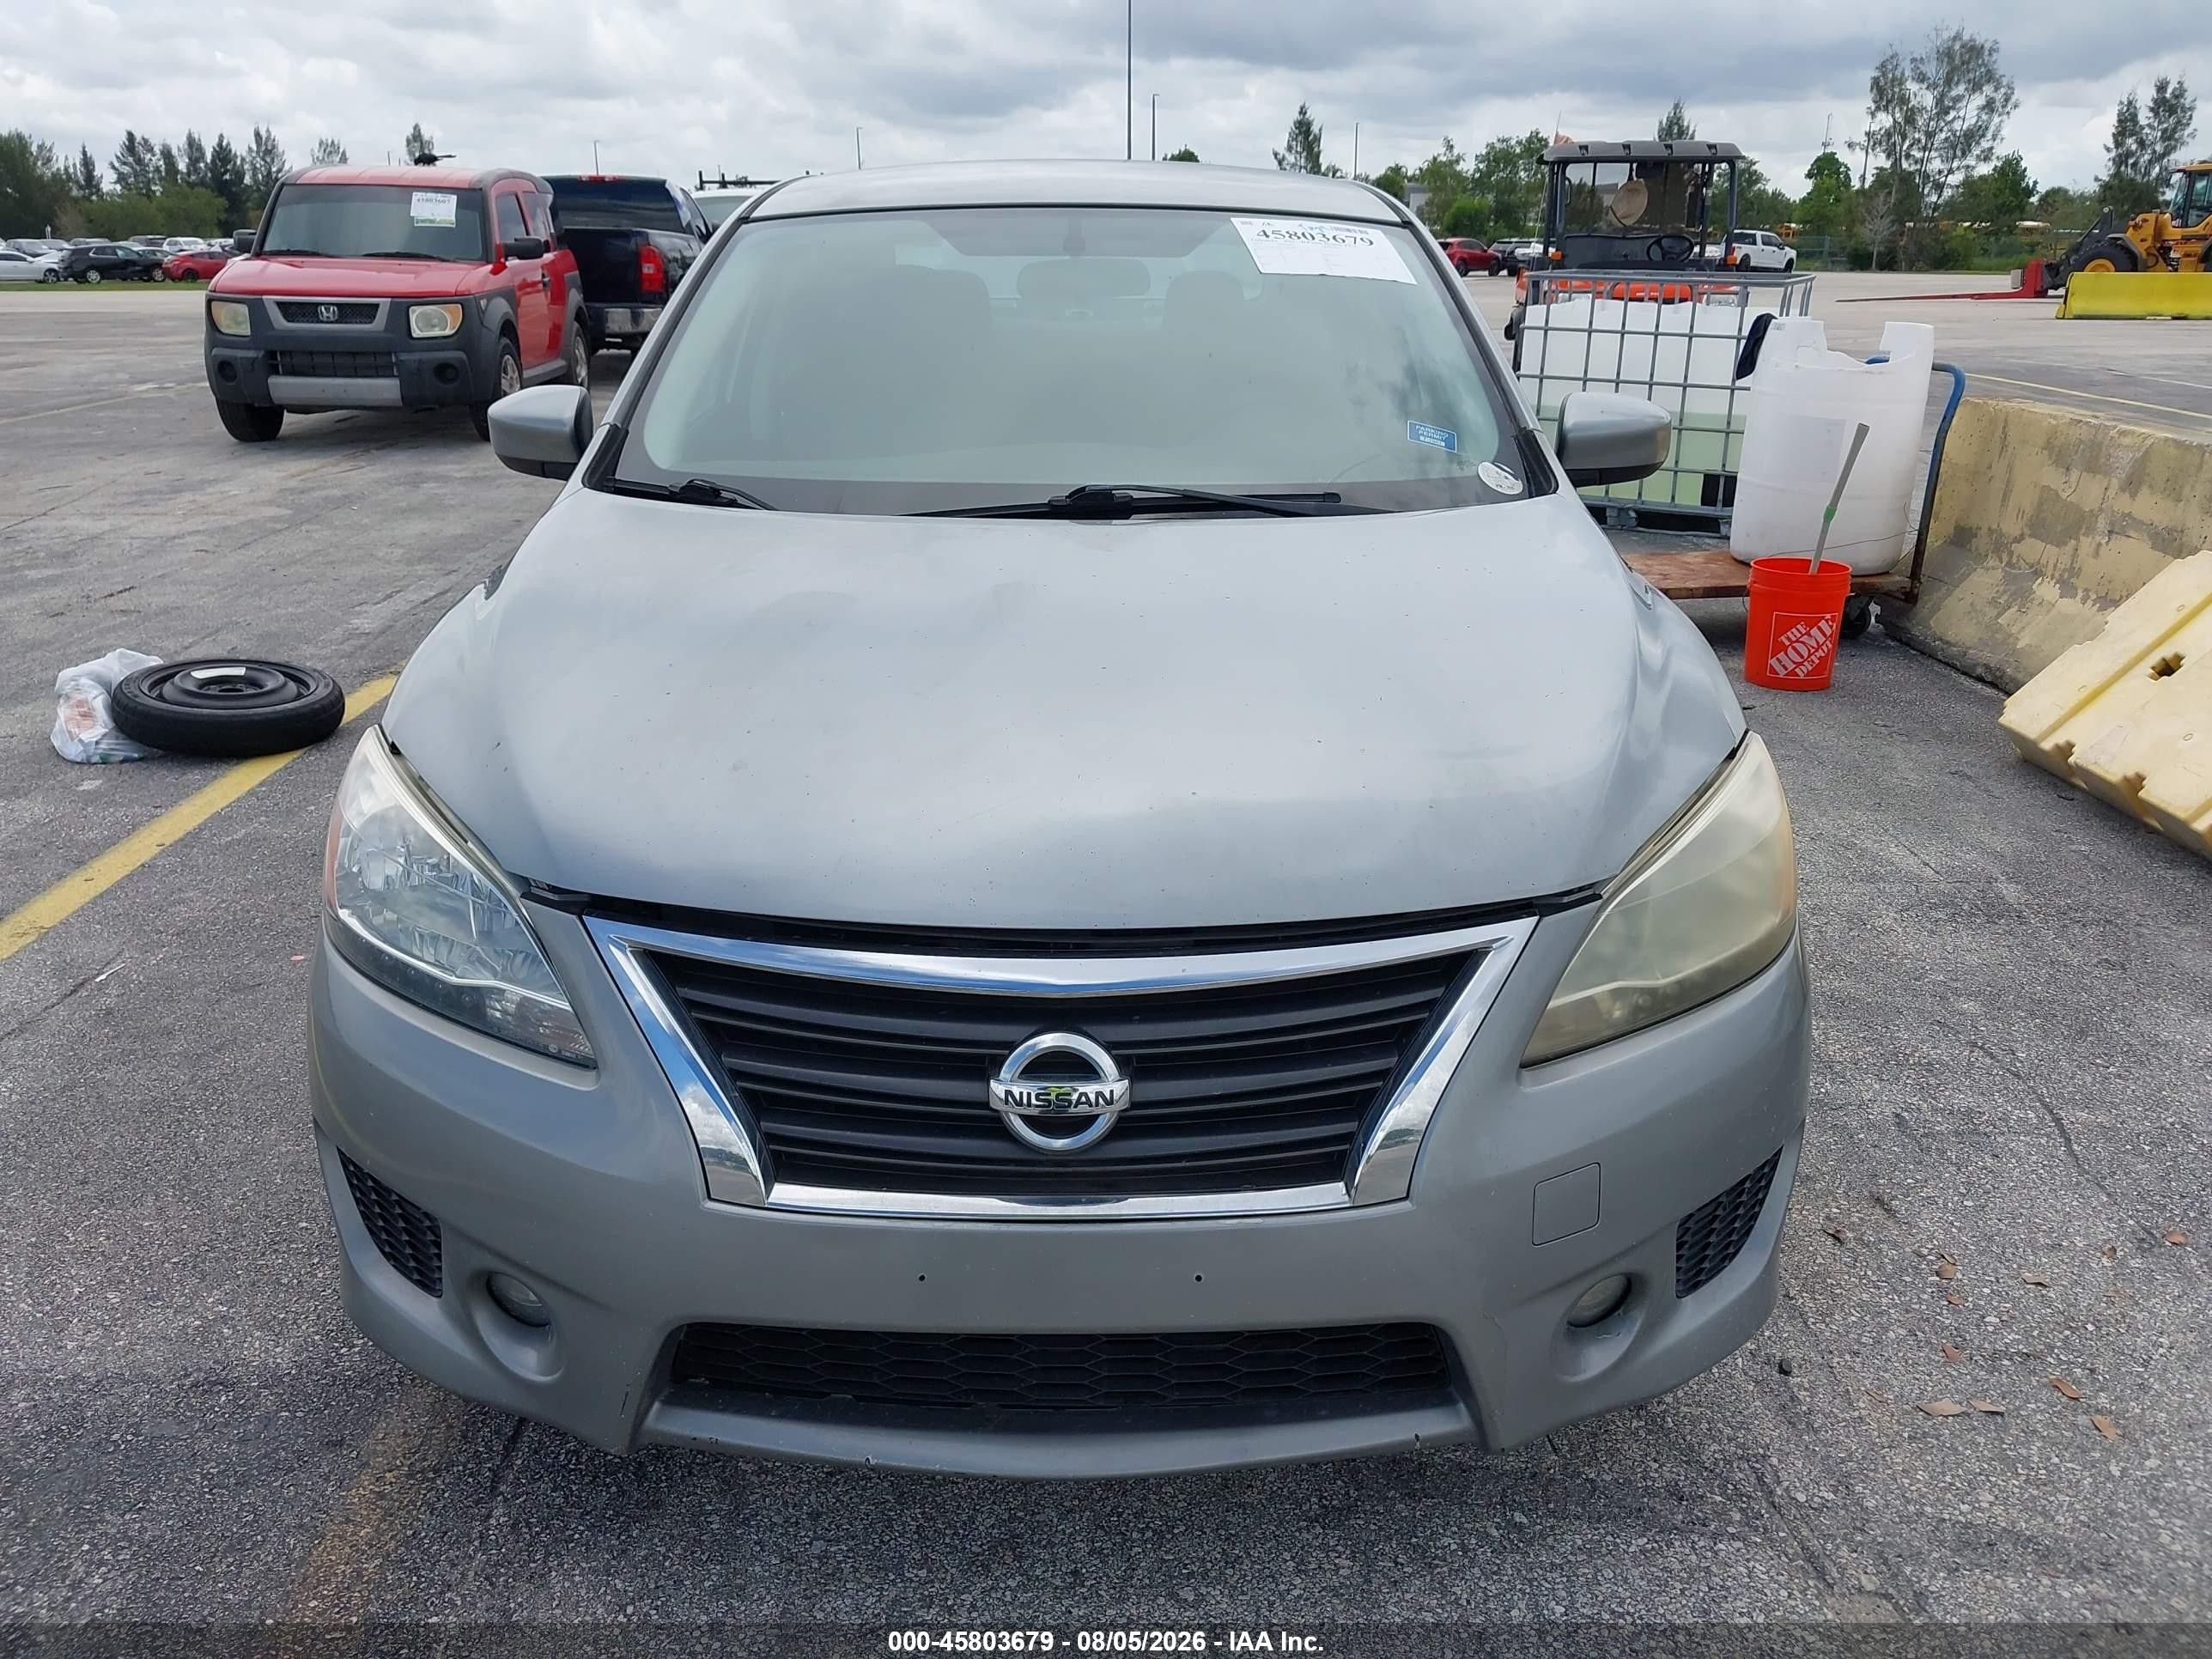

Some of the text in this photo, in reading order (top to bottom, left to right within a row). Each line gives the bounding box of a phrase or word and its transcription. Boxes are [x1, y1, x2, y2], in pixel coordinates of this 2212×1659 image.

[1256, 228, 1375, 247] 45803679
[1415, 424, 1449, 438] PARKING
[1419, 429, 1447, 441] PERMIT
[1778, 621, 1809, 646] THE
[1770, 615, 1836, 676] HOME
[1794, 637, 1832, 678] DEPOT
[1003, 1088, 1115, 1109] NISSAN
